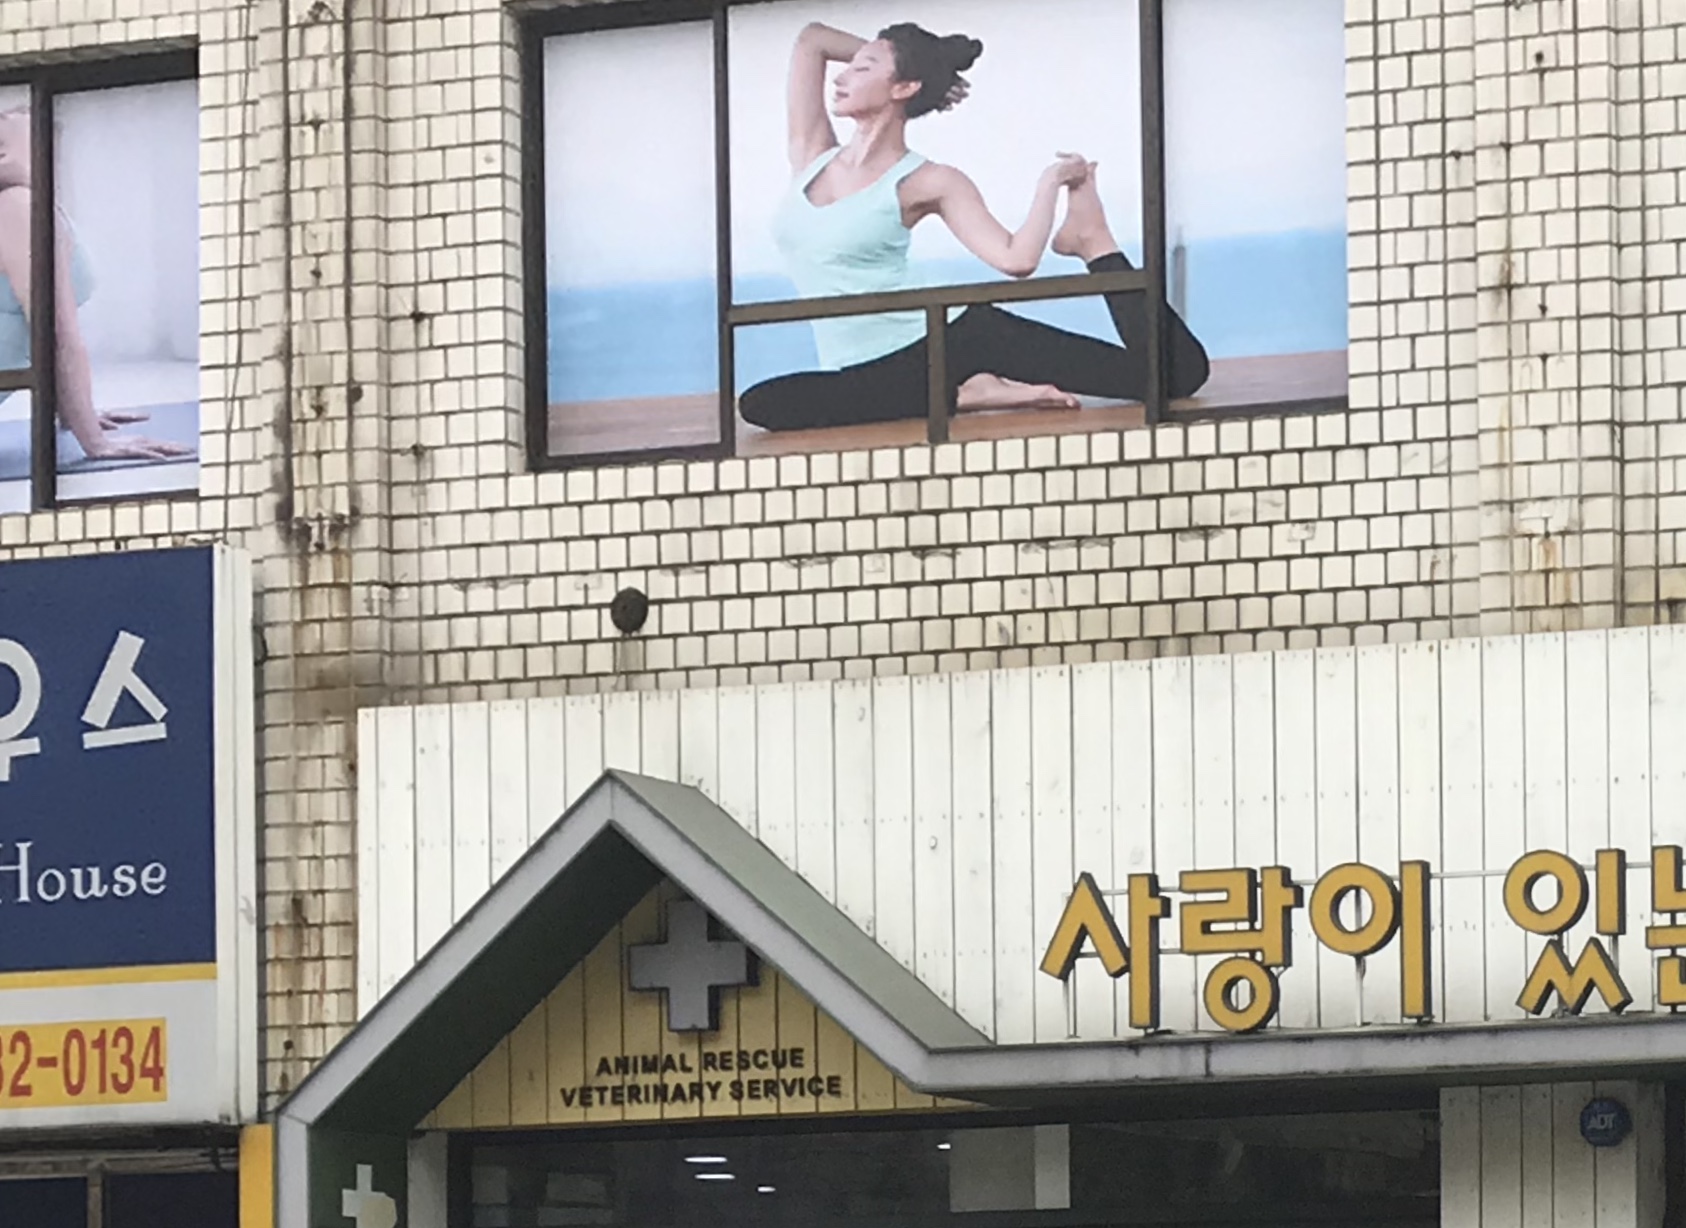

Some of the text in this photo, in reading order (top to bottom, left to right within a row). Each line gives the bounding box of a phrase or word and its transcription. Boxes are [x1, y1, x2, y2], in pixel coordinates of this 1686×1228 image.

[1039, 860, 1431, 1033] 사랑이
[0, 1026, 164, 1097] 2-0134
[595, 1048, 805, 1077] ANIMAL RESCUE
[560, 1076, 842, 1107] VETERINARY SERVICE
